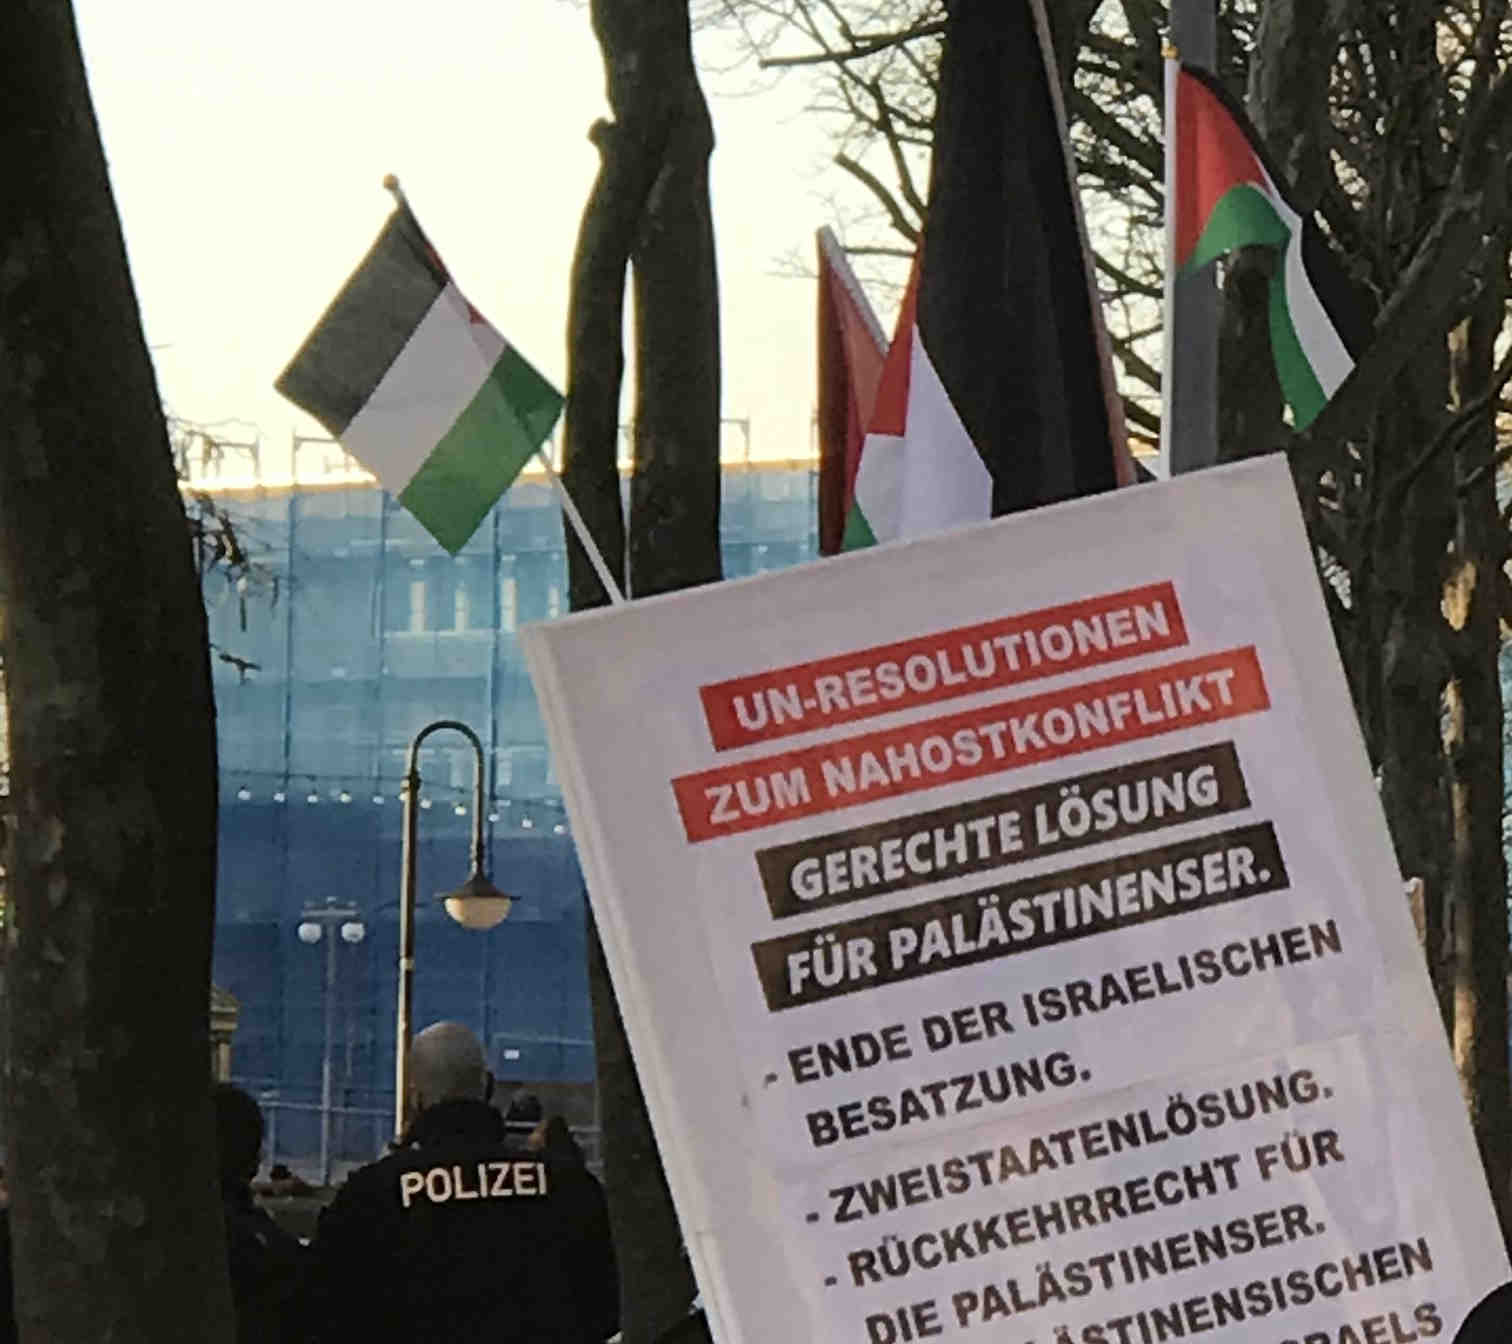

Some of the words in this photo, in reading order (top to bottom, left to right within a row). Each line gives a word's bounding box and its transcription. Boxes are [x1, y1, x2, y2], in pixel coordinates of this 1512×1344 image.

[734, 601, 1168, 732] UN-RESOLUTIONEN
[705, 769, 811, 825] ZUM
[823, 668, 1236, 805] NAHOSTKONFLIKT
[790, 813, 1025, 901] GERECHTE
[1037, 763, 1220, 846] LÖSUNG
[787, 934, 879, 996] FÜR
[890, 846, 1272, 963] PALÄSTINENSER.
[788, 1024, 912, 1087] ENDE
[923, 1001, 1014, 1056] DER
[1025, 919, 1343, 1026] ISRAELISCHEN
[807, 1053, 1091, 1148] BESATZUNG.
[830, 1067, 1333, 1224] ZWEISTAATENLÖSUNG.
[400, 1161, 548, 1208] POLIZEI
[847, 1153, 1242, 1289] RÜCKKEHRRECHT
[1257, 1129, 1346, 1181] FÜR
[955, 1203, 1326, 1328] PALÄSTINENSER.
